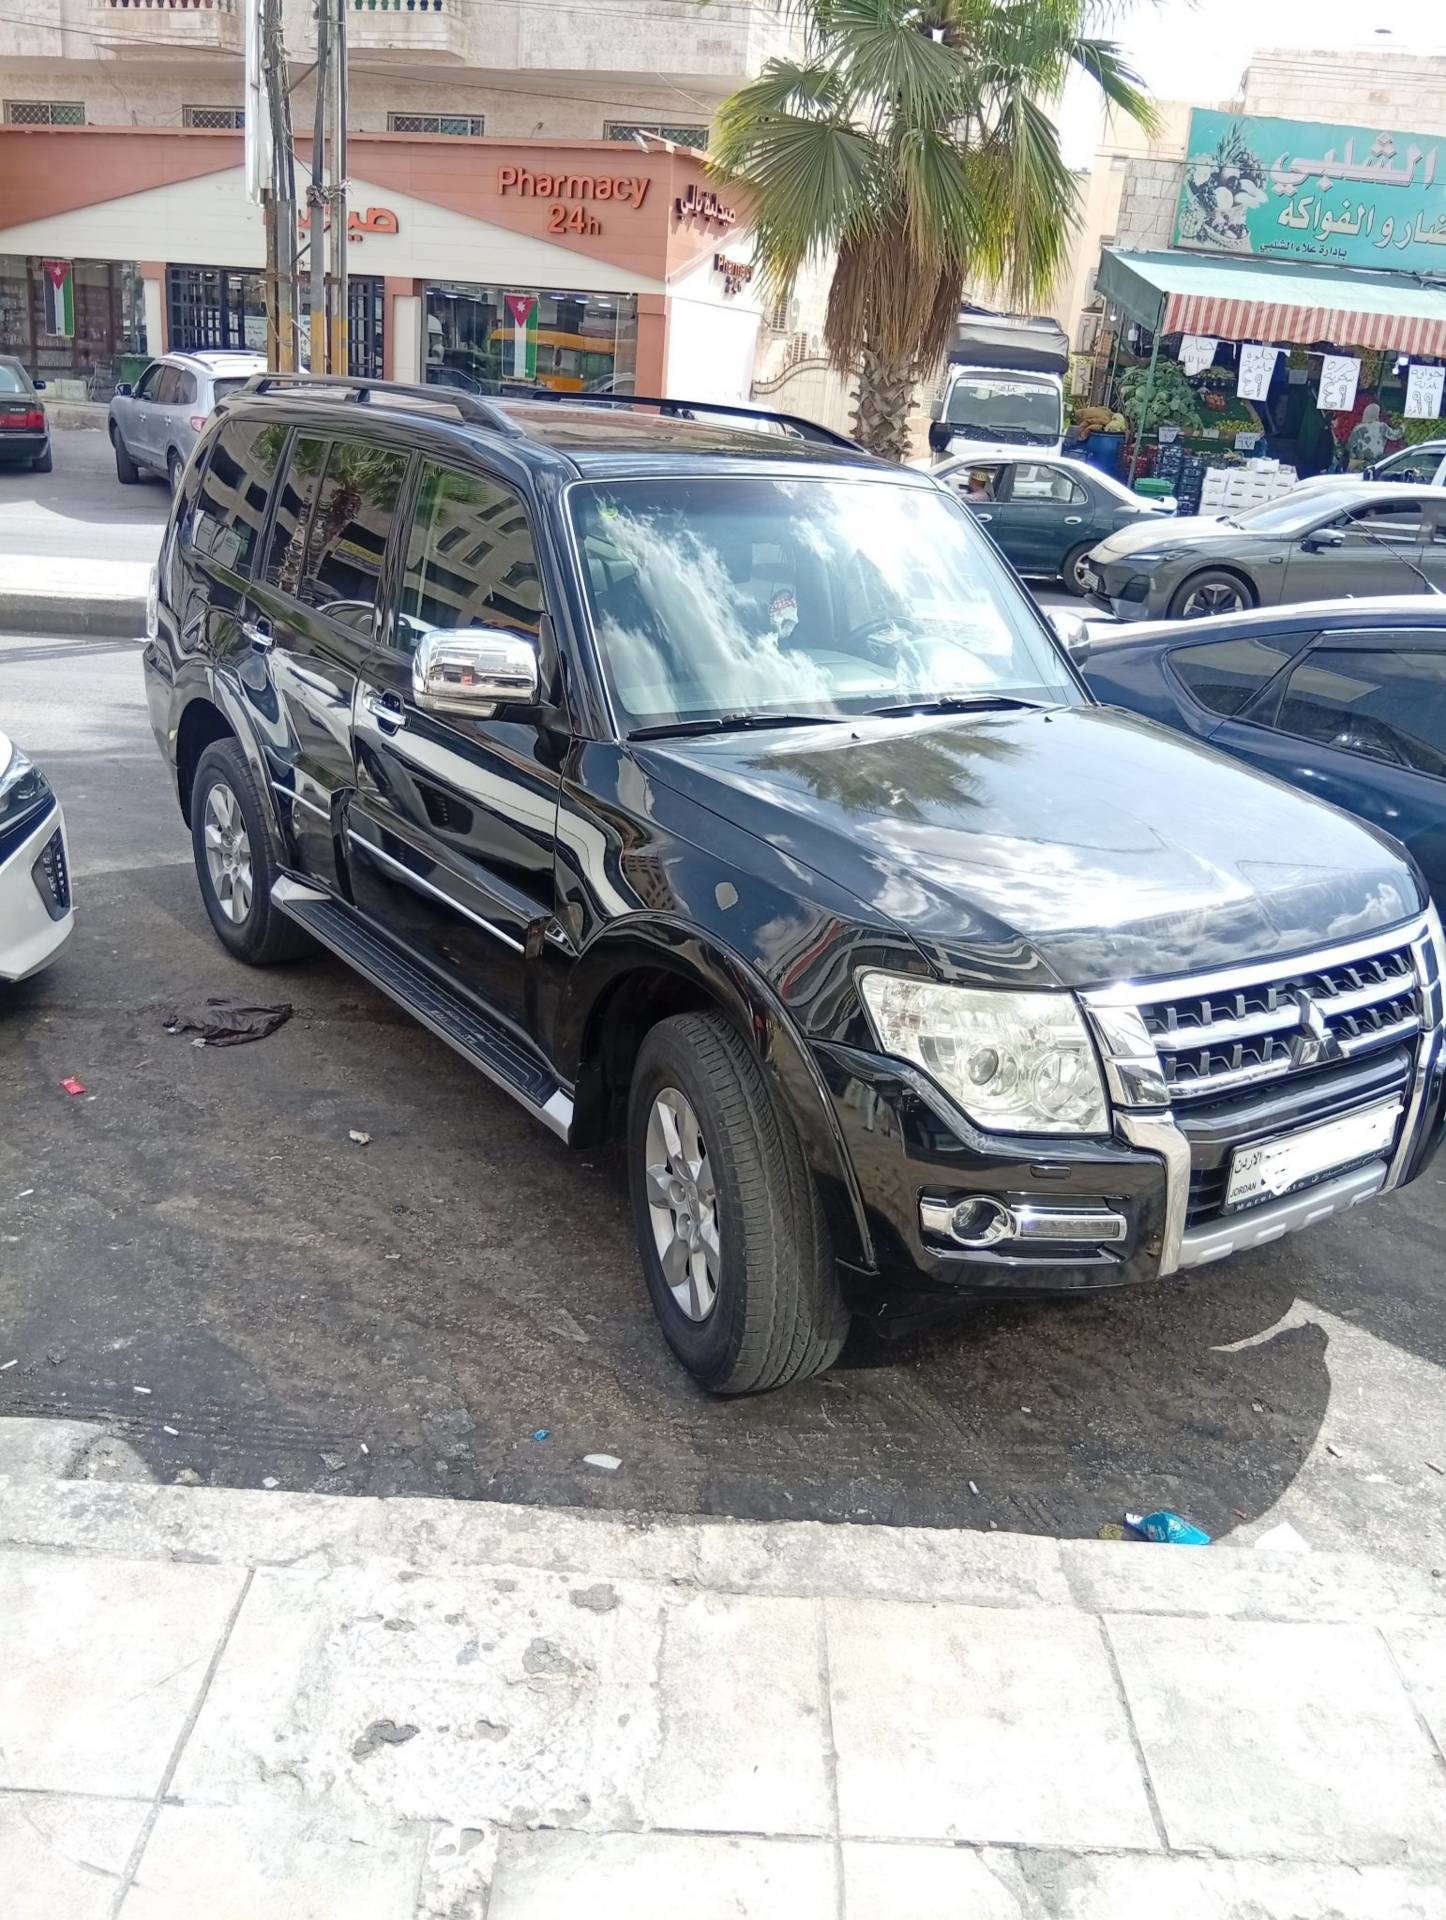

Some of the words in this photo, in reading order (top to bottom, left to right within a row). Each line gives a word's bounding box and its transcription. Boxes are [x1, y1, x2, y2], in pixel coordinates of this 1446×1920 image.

[1270, 132, 1439, 197] الشلبي
[497, 166, 650, 209] Pharmacy
[548, 203, 601, 236] 24h
[1260, 239, 1294, 253] الشلبي
[1230, 1181, 1257, 1198] JORDAN
